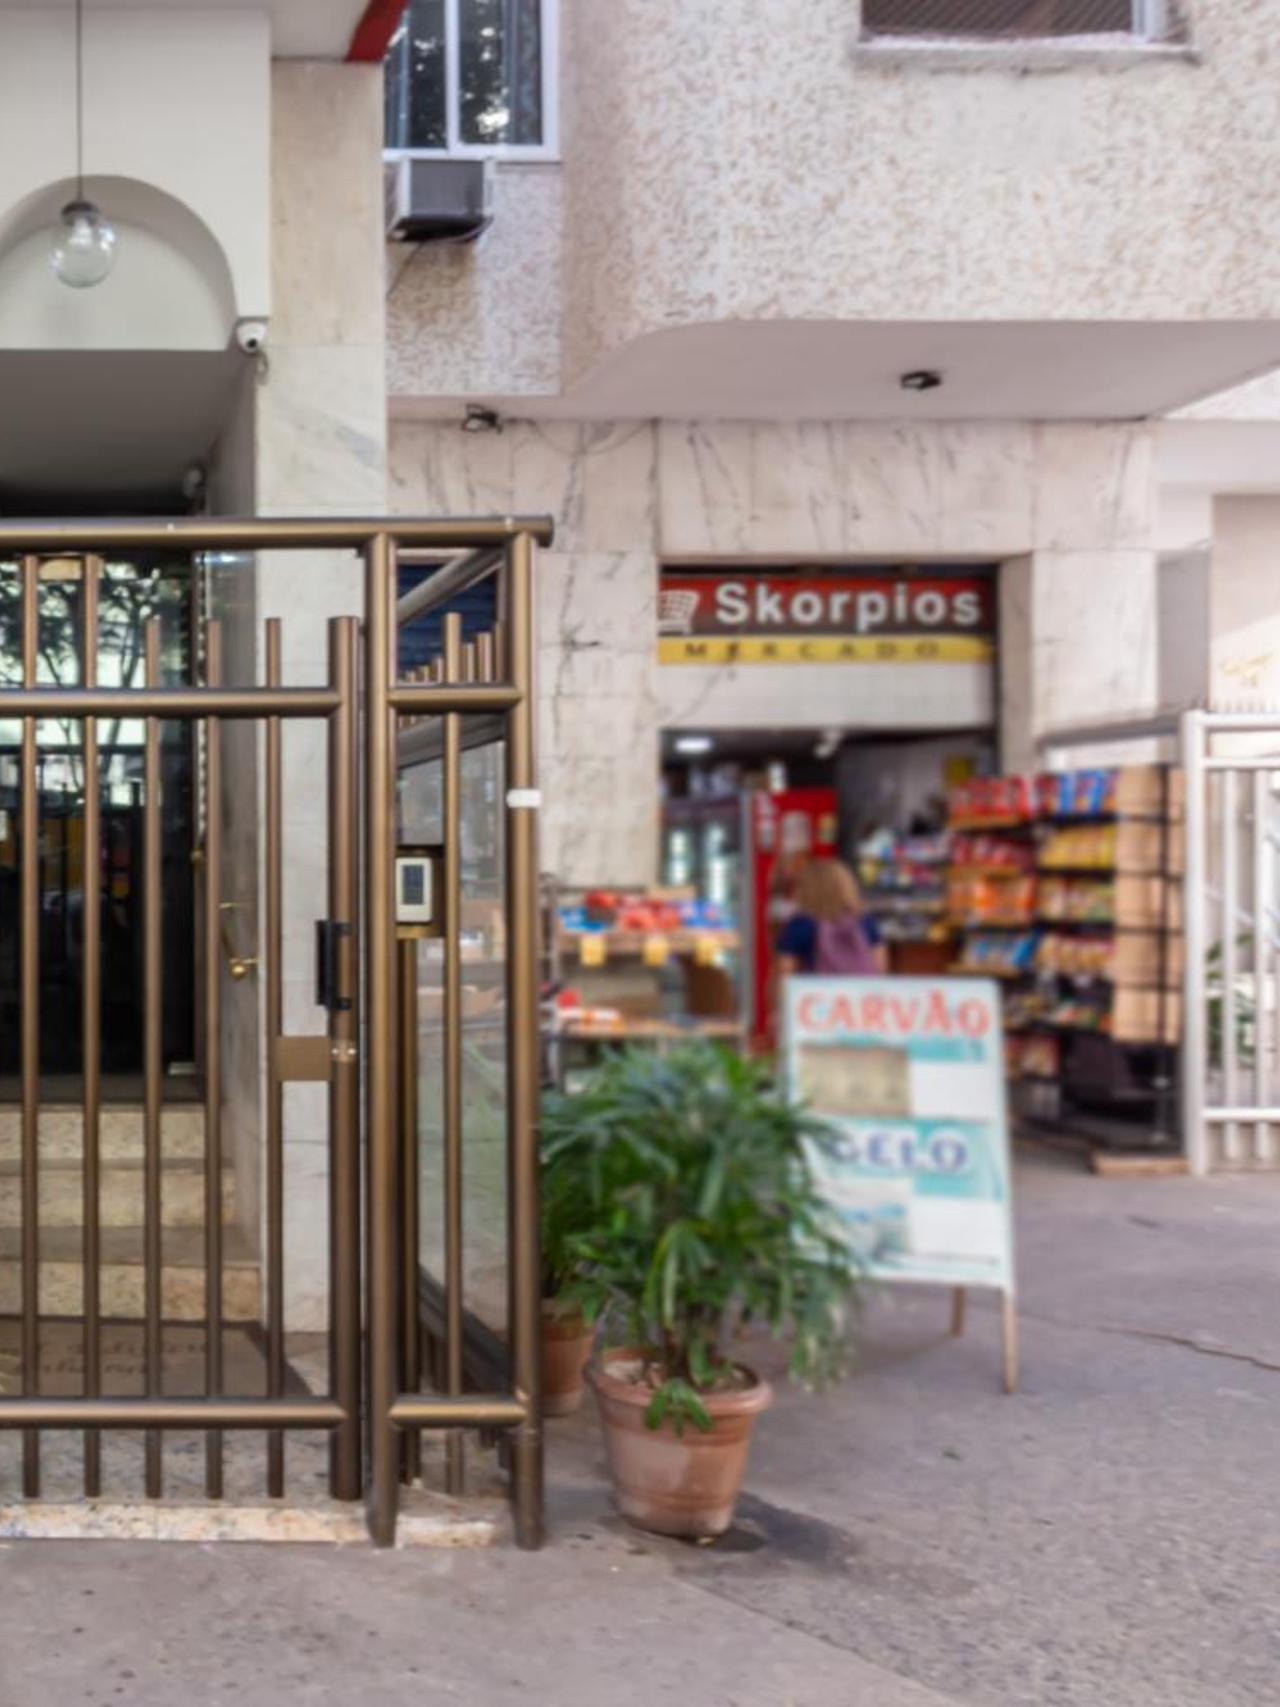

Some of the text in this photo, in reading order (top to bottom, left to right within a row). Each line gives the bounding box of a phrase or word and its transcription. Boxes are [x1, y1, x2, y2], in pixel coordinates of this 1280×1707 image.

[715, 582, 981, 632] Skorpios
[684, 641, 939, 659] MERCADO
[796, 989, 989, 1038] CARVÃO
[825, 1132, 968, 1170] GELO
